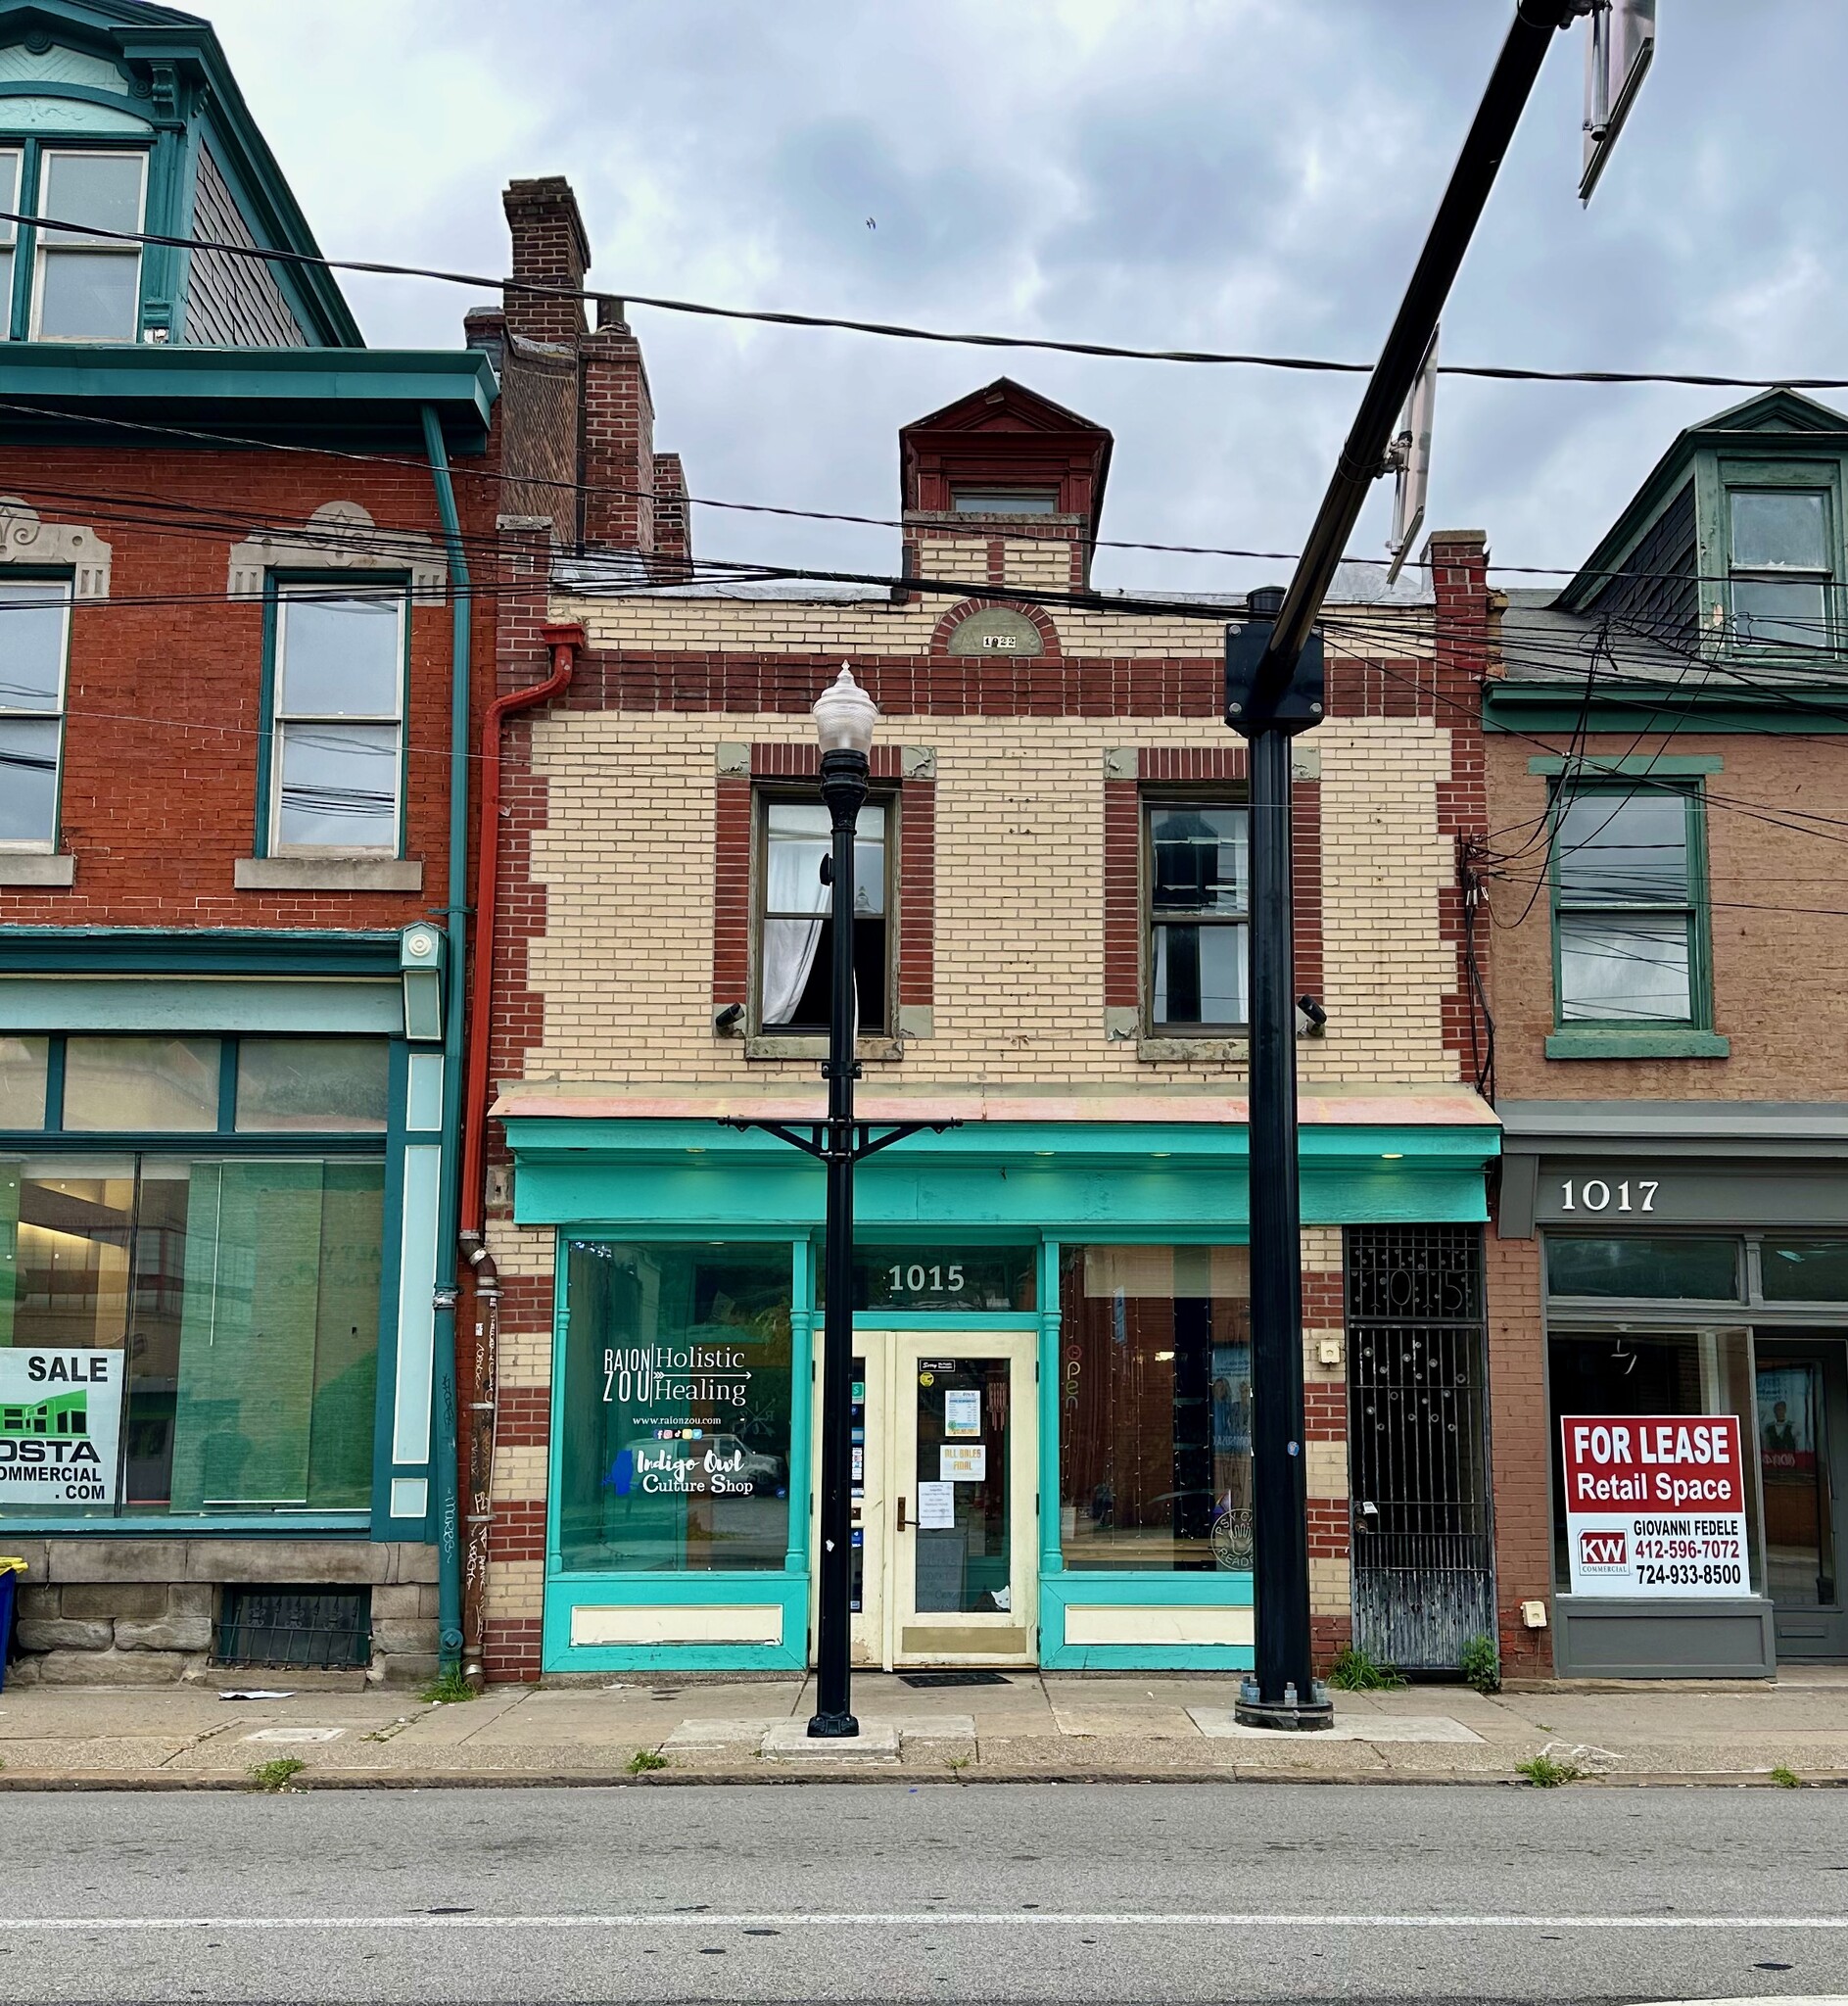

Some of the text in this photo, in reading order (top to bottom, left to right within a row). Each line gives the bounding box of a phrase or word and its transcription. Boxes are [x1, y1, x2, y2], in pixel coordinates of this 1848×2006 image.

[1562, 1179, 1659, 1212] 1017
[888, 1265, 965, 1291] 1015
[604, 1349, 650, 1371] RAION
[655, 1347, 745, 1368] Holistic
[28, 1357, 108, 1382] SALE
[603, 1370, 649, 1402] ZOU
[655, 1379, 746, 1407] Healing
[633, 1416, 722, 1425] www.raionzou.com
[945, 1449, 981, 1458] ALL SALES
[1574, 1426, 1730, 1463] FOR LEASE
[638, 1450, 745, 1482] Indigo Owl
[642, 1474, 753, 1495] Culture Shop
[1577, 1472, 1731, 1506] Retail Space
[1634, 1520, 1738, 1536] GIOVANNI FEDELE
[1581, 1539, 1624, 1562] KW
[1635, 1540, 1739, 1558] 412-596-7072
[1636, 1564, 1740, 1585] 724-933-8500
